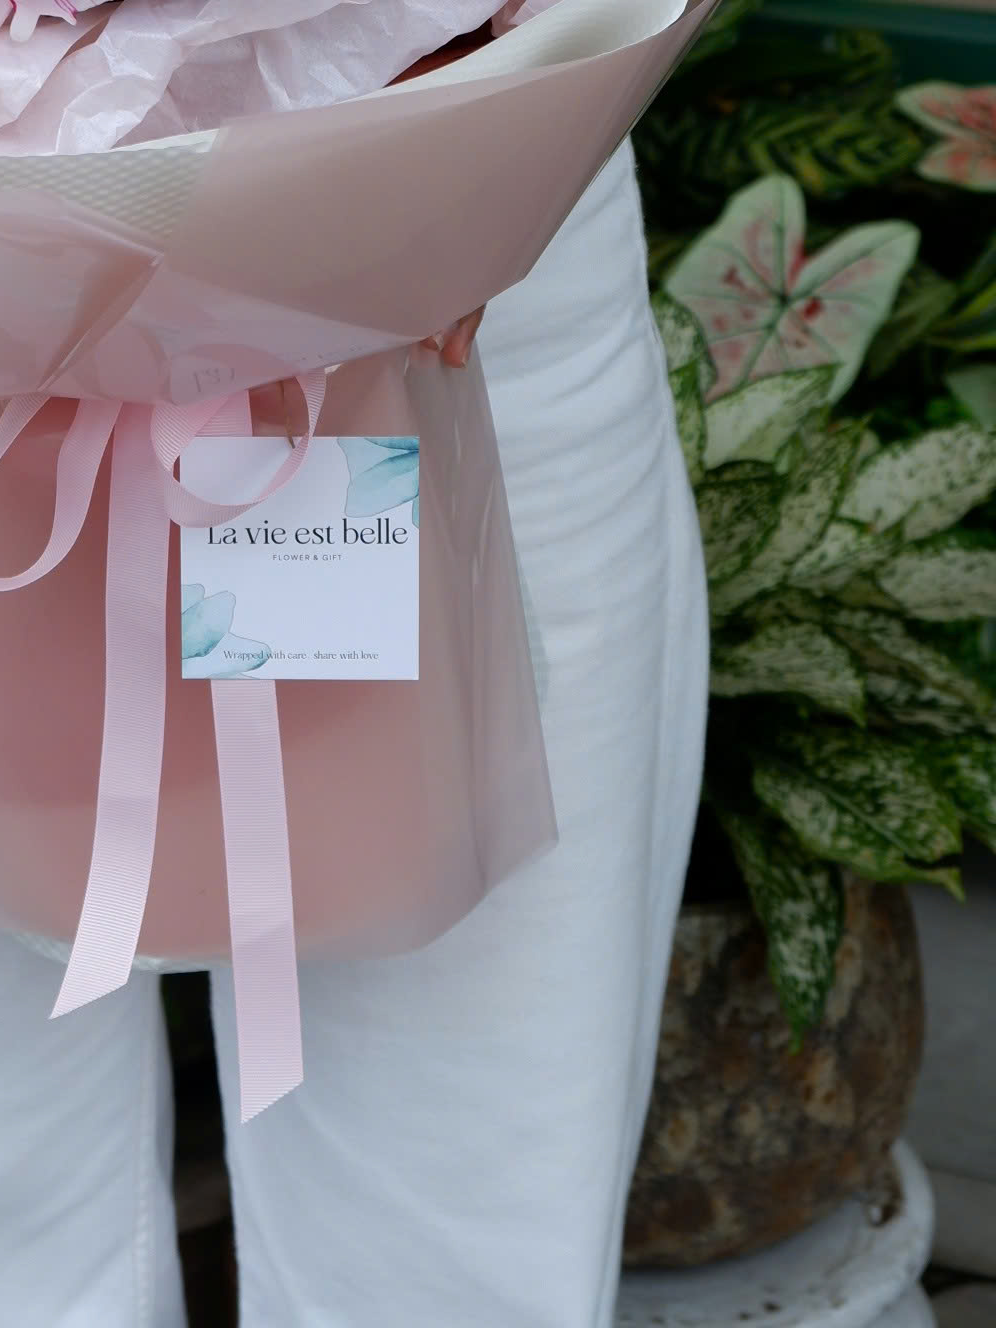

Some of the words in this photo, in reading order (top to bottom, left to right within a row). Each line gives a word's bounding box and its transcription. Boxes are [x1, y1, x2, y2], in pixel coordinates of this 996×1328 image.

[207, 526, 237, 544] La
[245, 520, 287, 544] vie
[295, 526, 335, 545] est
[342, 518, 409, 545] belle
[223, 650, 264, 662] Wrapped
[266, 650, 286, 660] with
[314, 650, 337, 660] share
[339, 650, 359, 660] with
[361, 650, 379, 660] love
